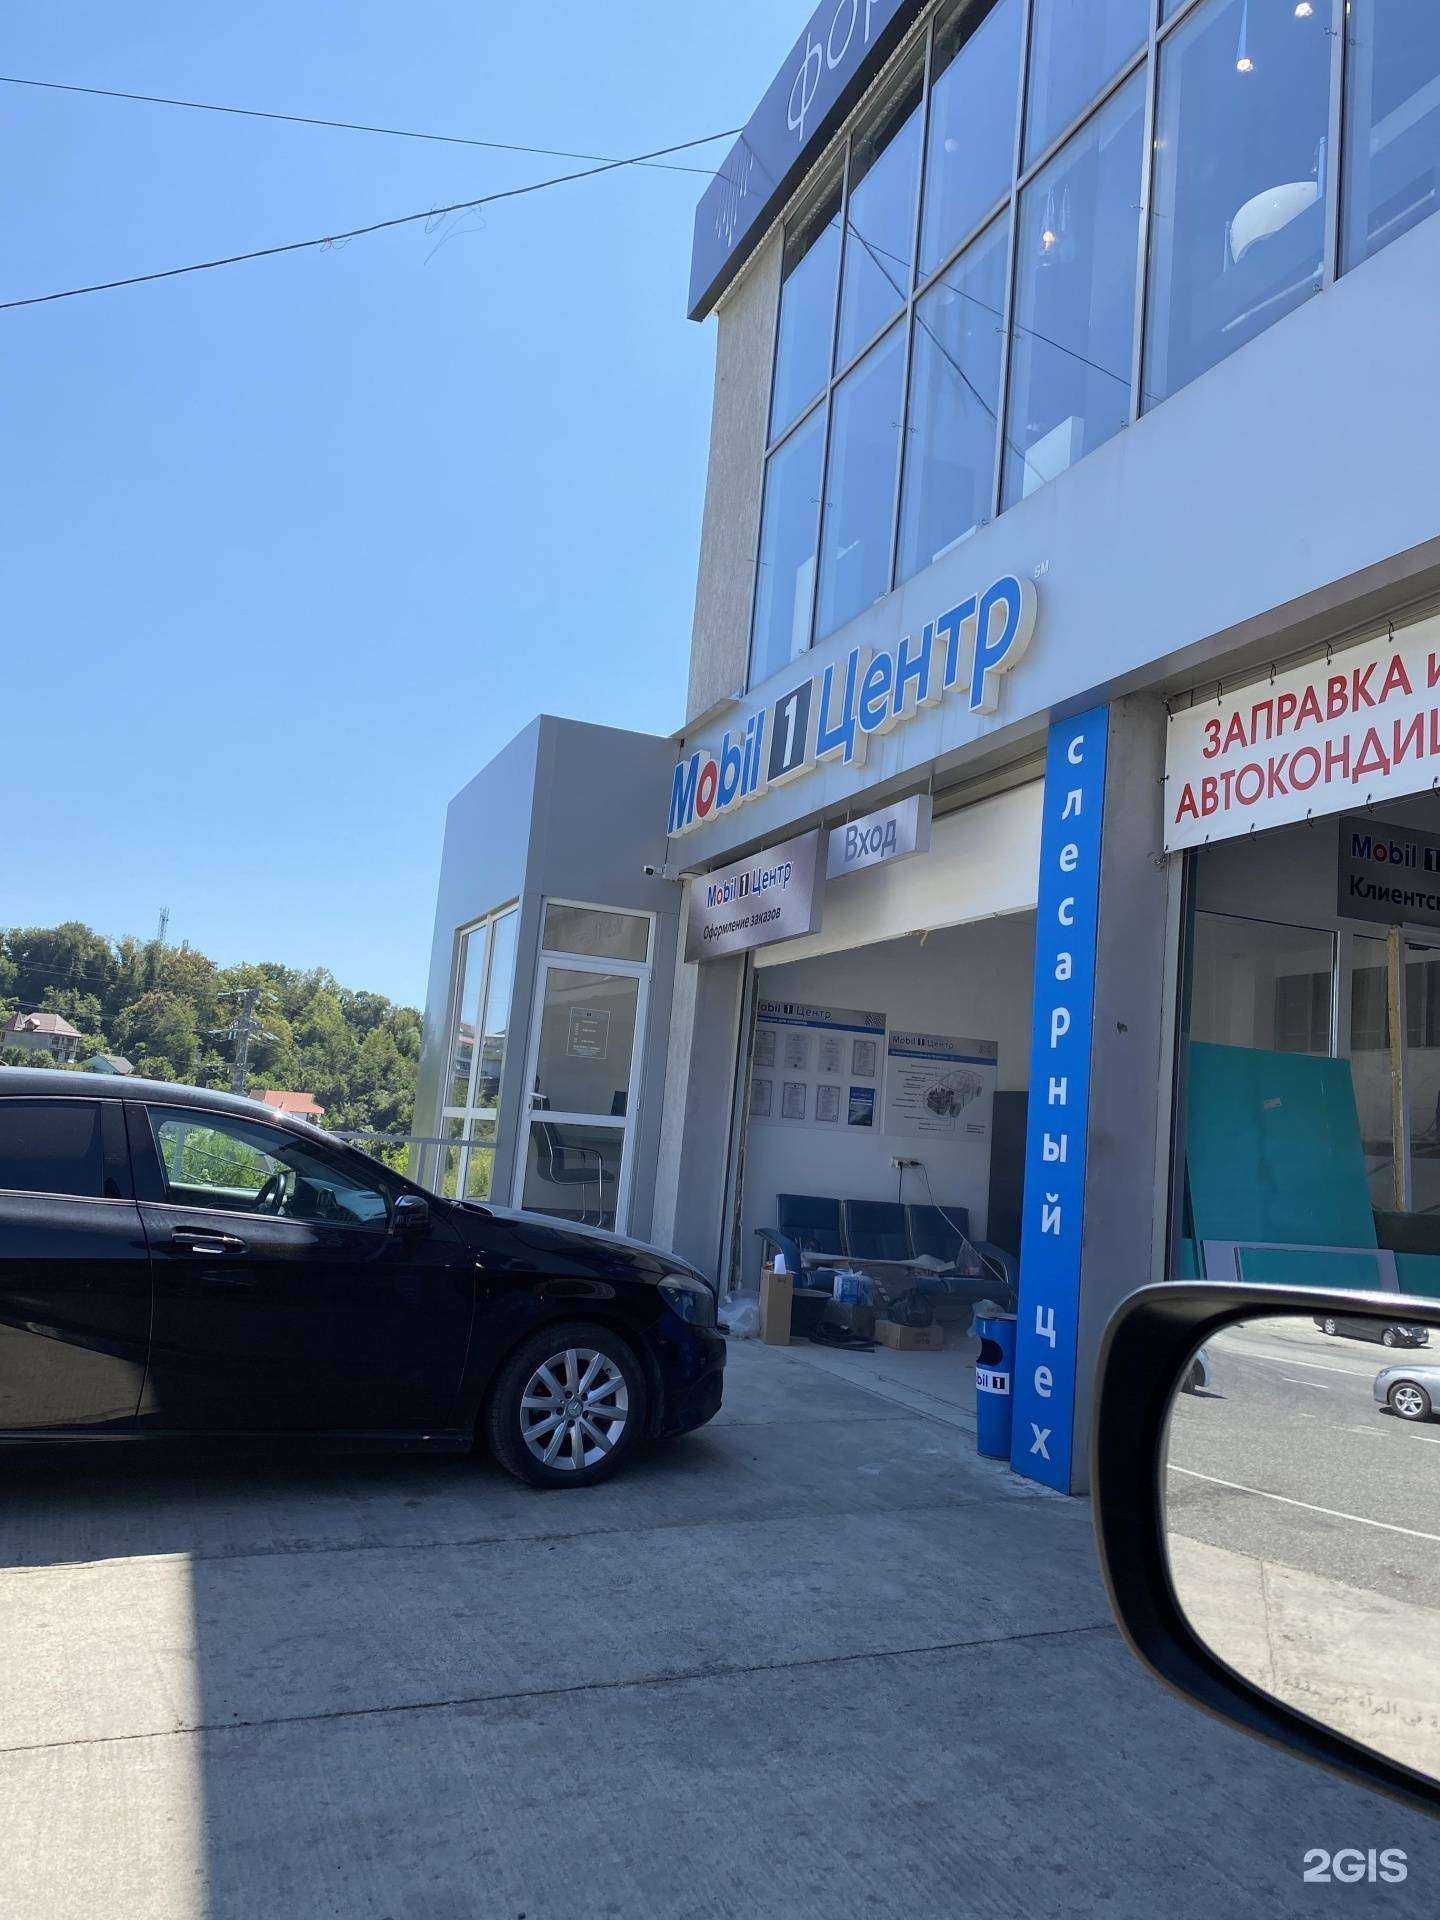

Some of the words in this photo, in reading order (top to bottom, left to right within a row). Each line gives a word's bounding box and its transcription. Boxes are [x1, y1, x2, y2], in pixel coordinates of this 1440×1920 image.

[667, 708, 767, 837] Mobil
[815, 574, 1026, 767] Центр
[1202, 654, 1413, 759] ЗАПРАВКА
[844, 818, 897, 862] Вход
[1352, 832, 1417, 869] Mobil
[706, 876, 737, 908] Mobil
[752, 861, 792, 897] Центр
[703, 916, 750, 942] Оформление
[750, 907, 781, 927] заказов
[1041, 734, 1085, 1236] слесарный
[796, 1004, 832, 1020] Центр
[892, 1035, 916, 1046] Mobil
[976, 1371, 988, 1388] bil
[1029, 1304, 1057, 1462] цех
